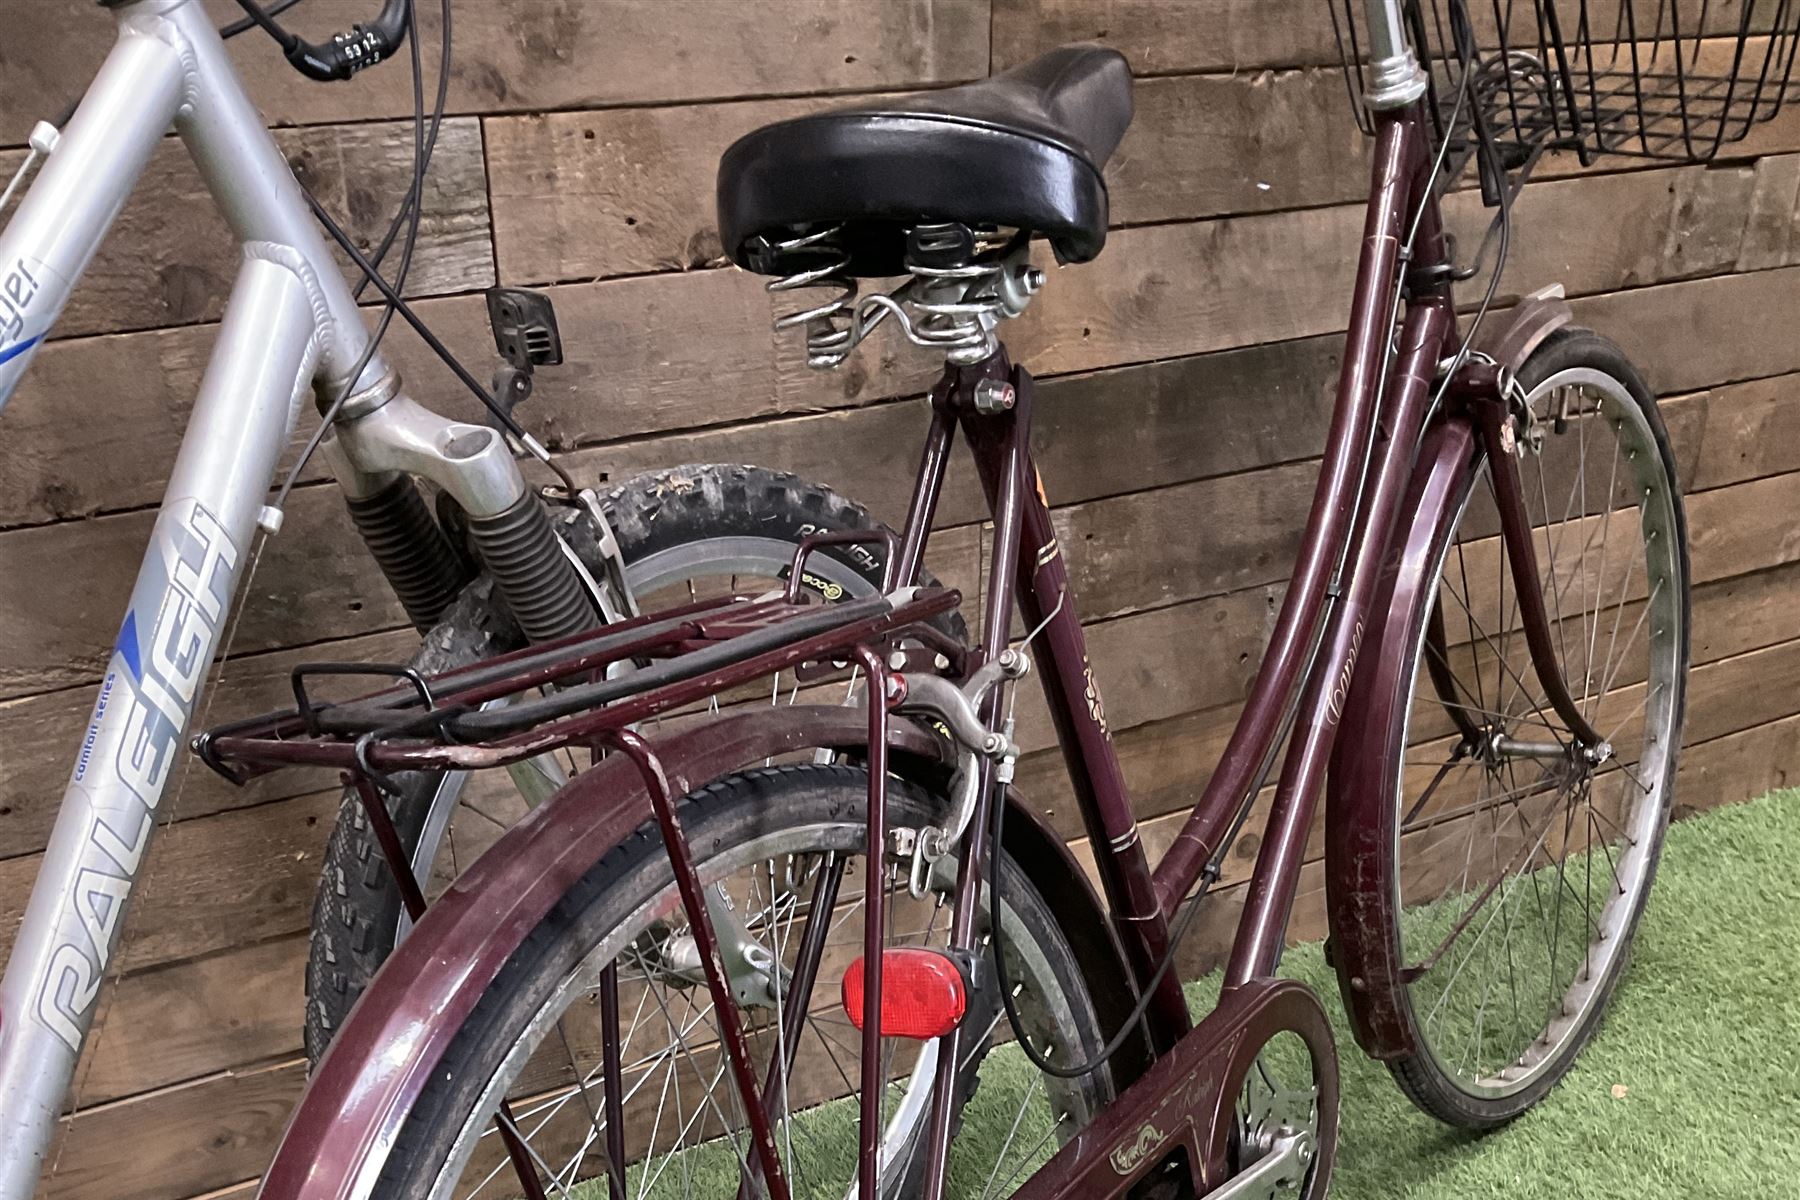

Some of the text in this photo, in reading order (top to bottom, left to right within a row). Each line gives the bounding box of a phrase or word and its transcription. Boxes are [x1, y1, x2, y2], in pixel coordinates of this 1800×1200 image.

[36, 502, 239, 1053] RALEIGH
[75, 673, 116, 782] comfort series
